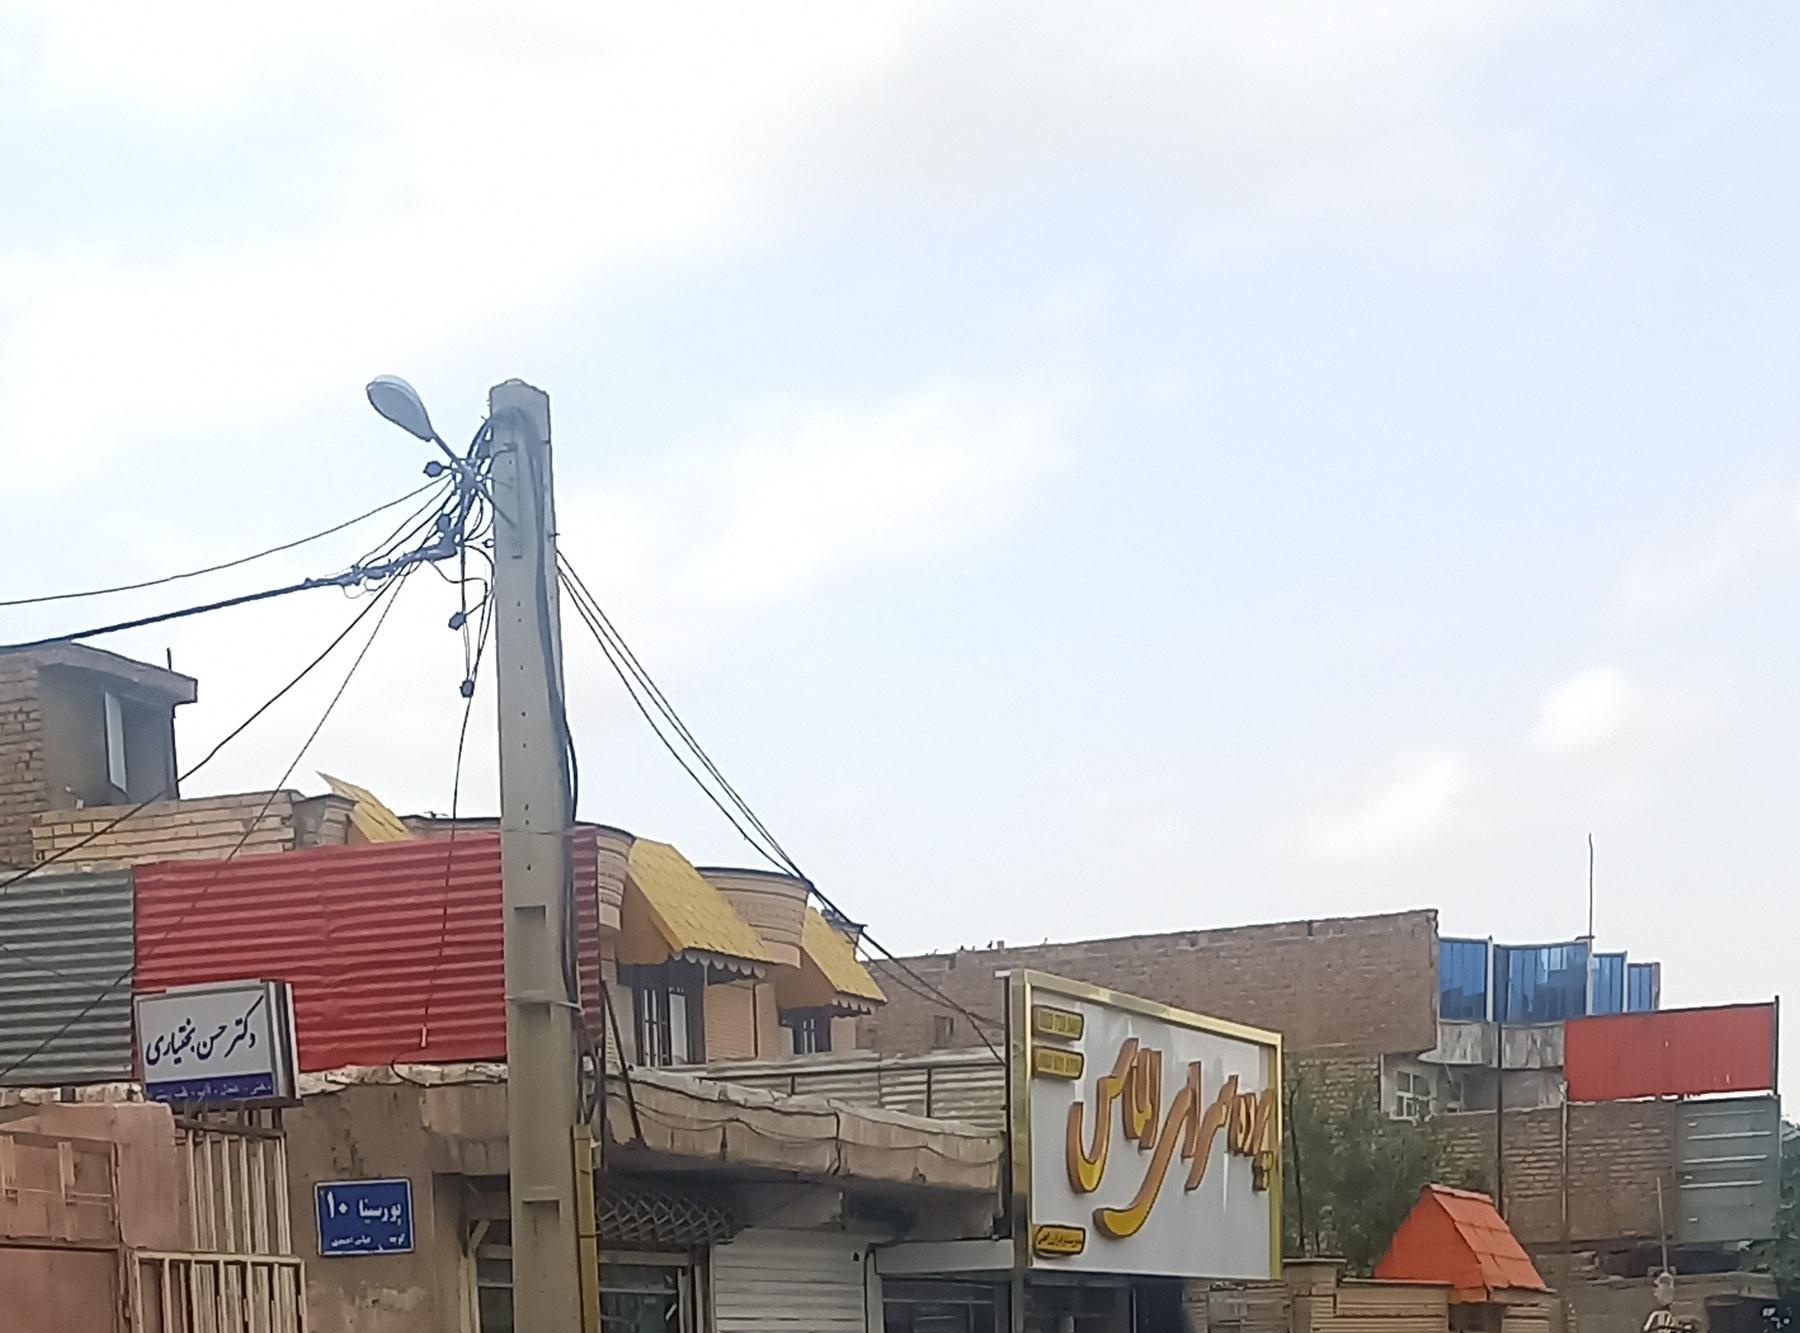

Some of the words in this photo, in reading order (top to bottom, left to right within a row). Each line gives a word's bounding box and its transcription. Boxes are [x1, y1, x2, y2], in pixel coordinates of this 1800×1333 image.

[145, 1017, 197, 1067] بختیاری
[196, 1025, 228, 1061] حسن
[224, 994, 265, 1059] دکتر
[327, 1190, 349, 1219] ۱۰
[359, 1198, 402, 1227] پورسینا
